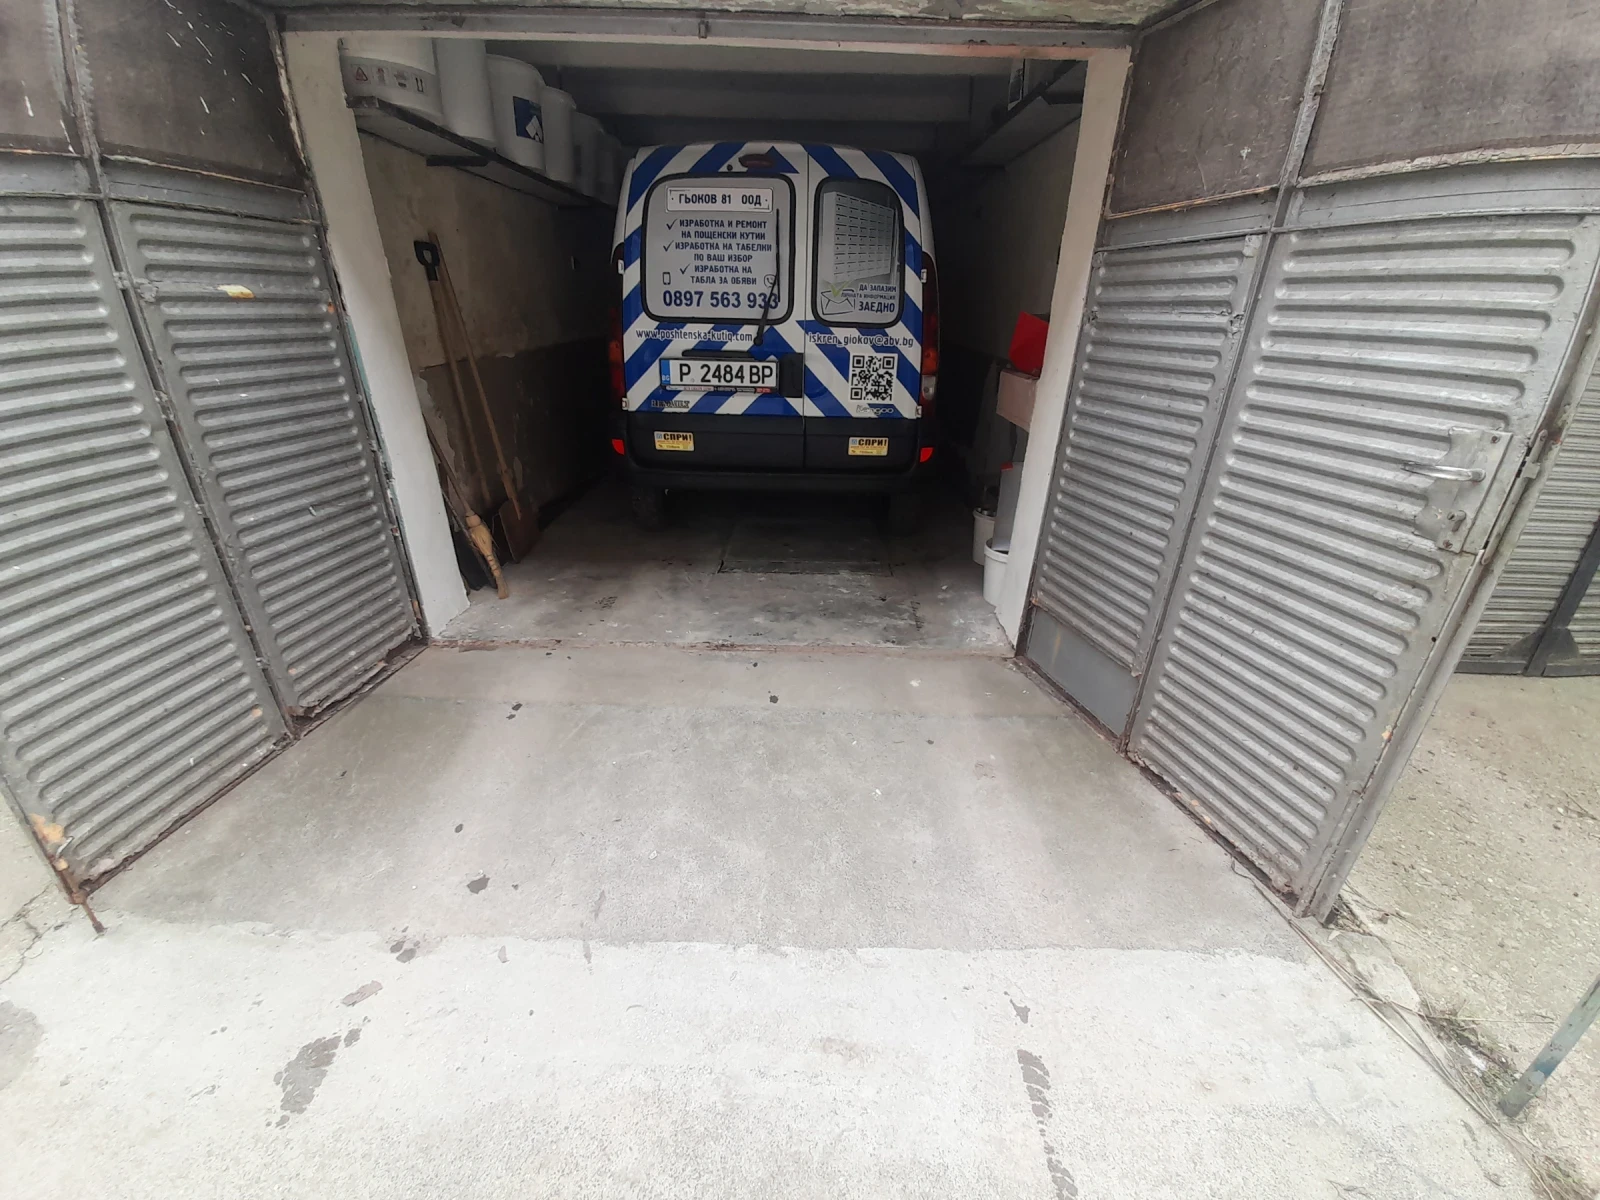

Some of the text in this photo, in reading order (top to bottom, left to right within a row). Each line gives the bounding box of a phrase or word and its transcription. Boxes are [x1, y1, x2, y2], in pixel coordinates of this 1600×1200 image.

[679, 194, 761, 206] ГЬОКОВ 81 ООД
[680, 219, 767, 229] ИЗРАБОТКА И РЕМОНТ
[681, 230, 765, 240] НА ПОЩЕНСКИ КУТИИ
[675, 242, 772, 252] ИЗРАБОТКА НА ТАБЕЛКИ
[694, 253, 753, 263] ПО ВАШ ИЗБОР
[694, 265, 752, 274] ИЗРАБОТКА НА
[690, 276, 757, 285] ТАБЛА ЗА ОБЯВИ
[663, 290, 704, 307] 0897
[710, 291, 741, 308] 563
[859, 301, 895, 313] ЗАЕДНО
[636, 328, 753, 342] www.poshtenska-kutiq.com
[809, 333, 914, 347] iskren_giokov@abv.bg
[700, 364, 745, 383] 2484
[663, 433, 692, 441] СПРИ!
[858, 438, 887, 446] СПРИ!
